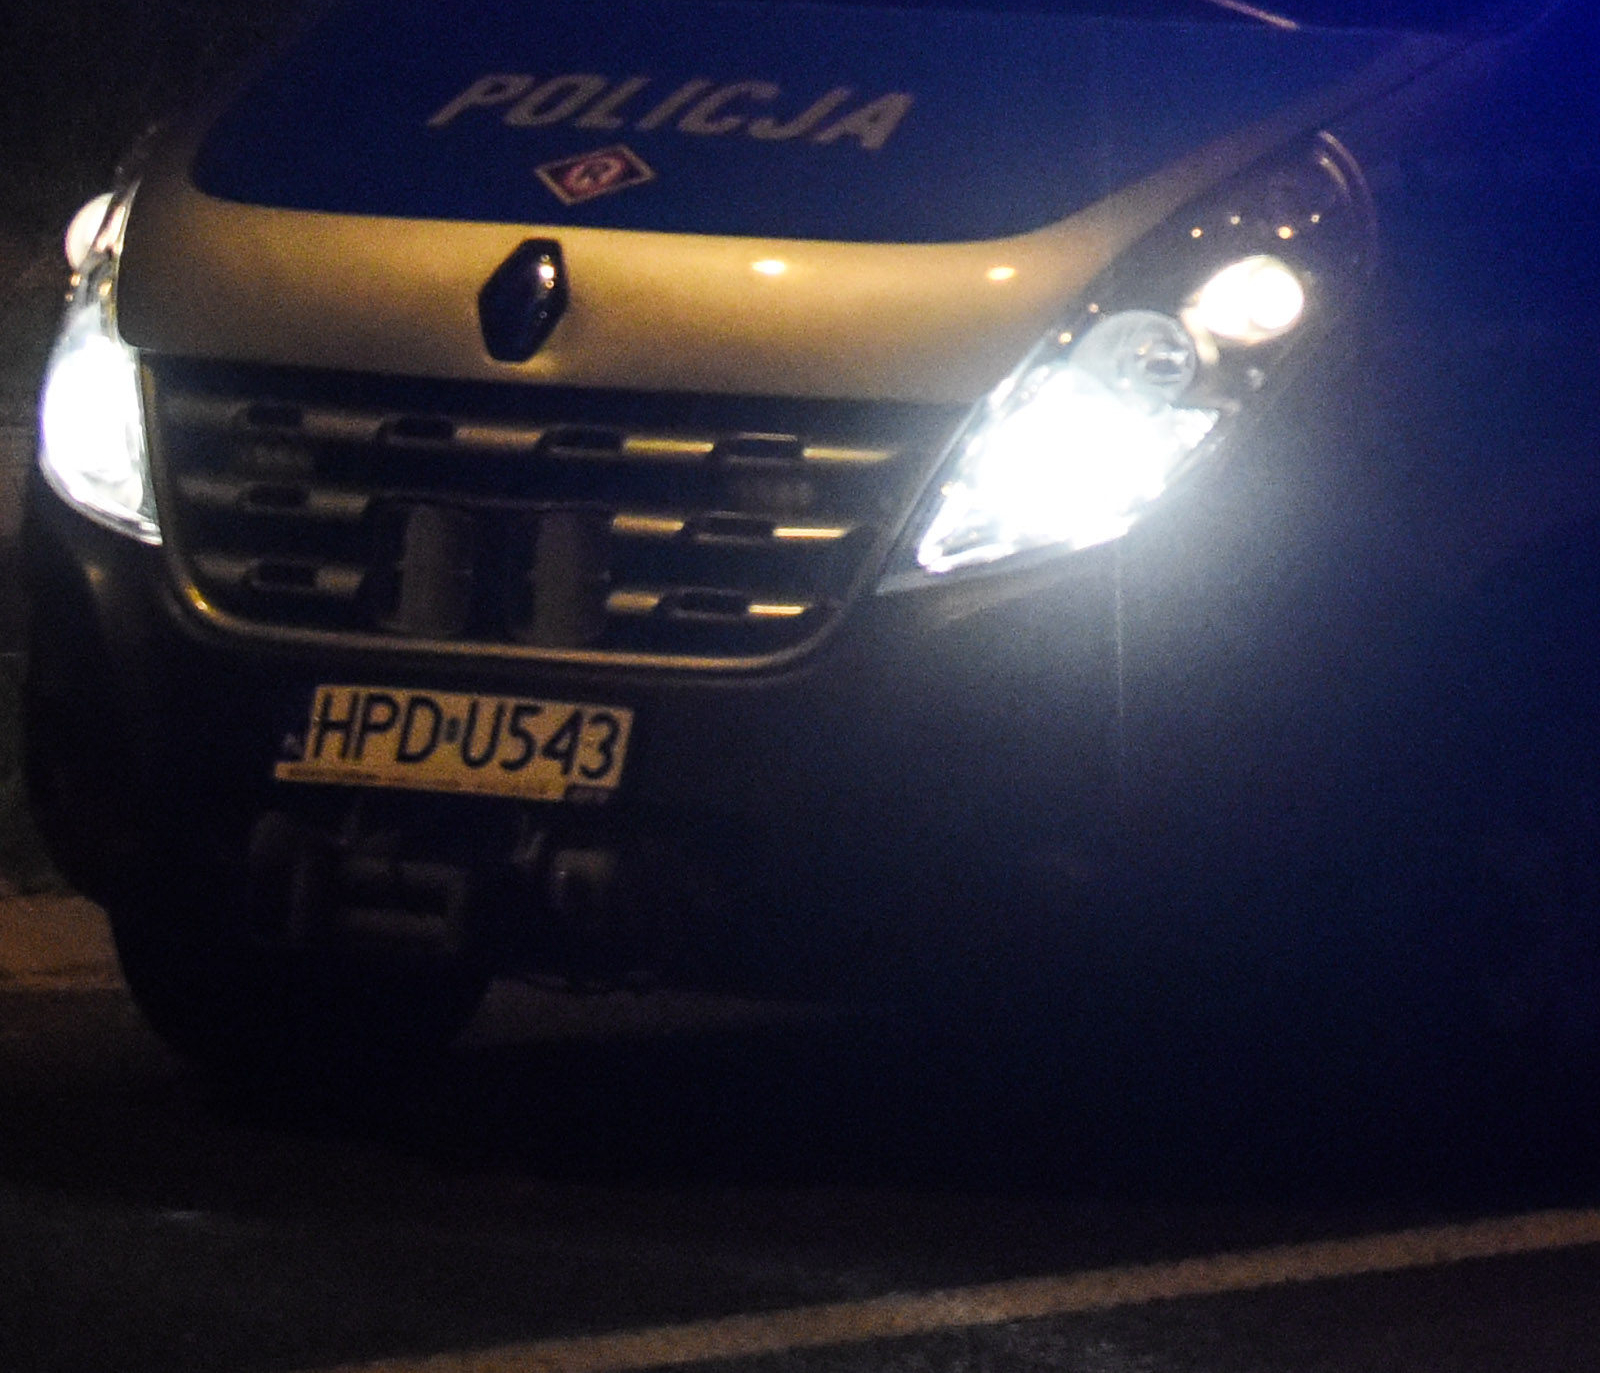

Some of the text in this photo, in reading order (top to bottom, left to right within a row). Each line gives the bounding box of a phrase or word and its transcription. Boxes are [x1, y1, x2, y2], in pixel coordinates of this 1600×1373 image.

[426, 72, 915, 150] POLICJA
[311, 691, 621, 780] HPD U543
